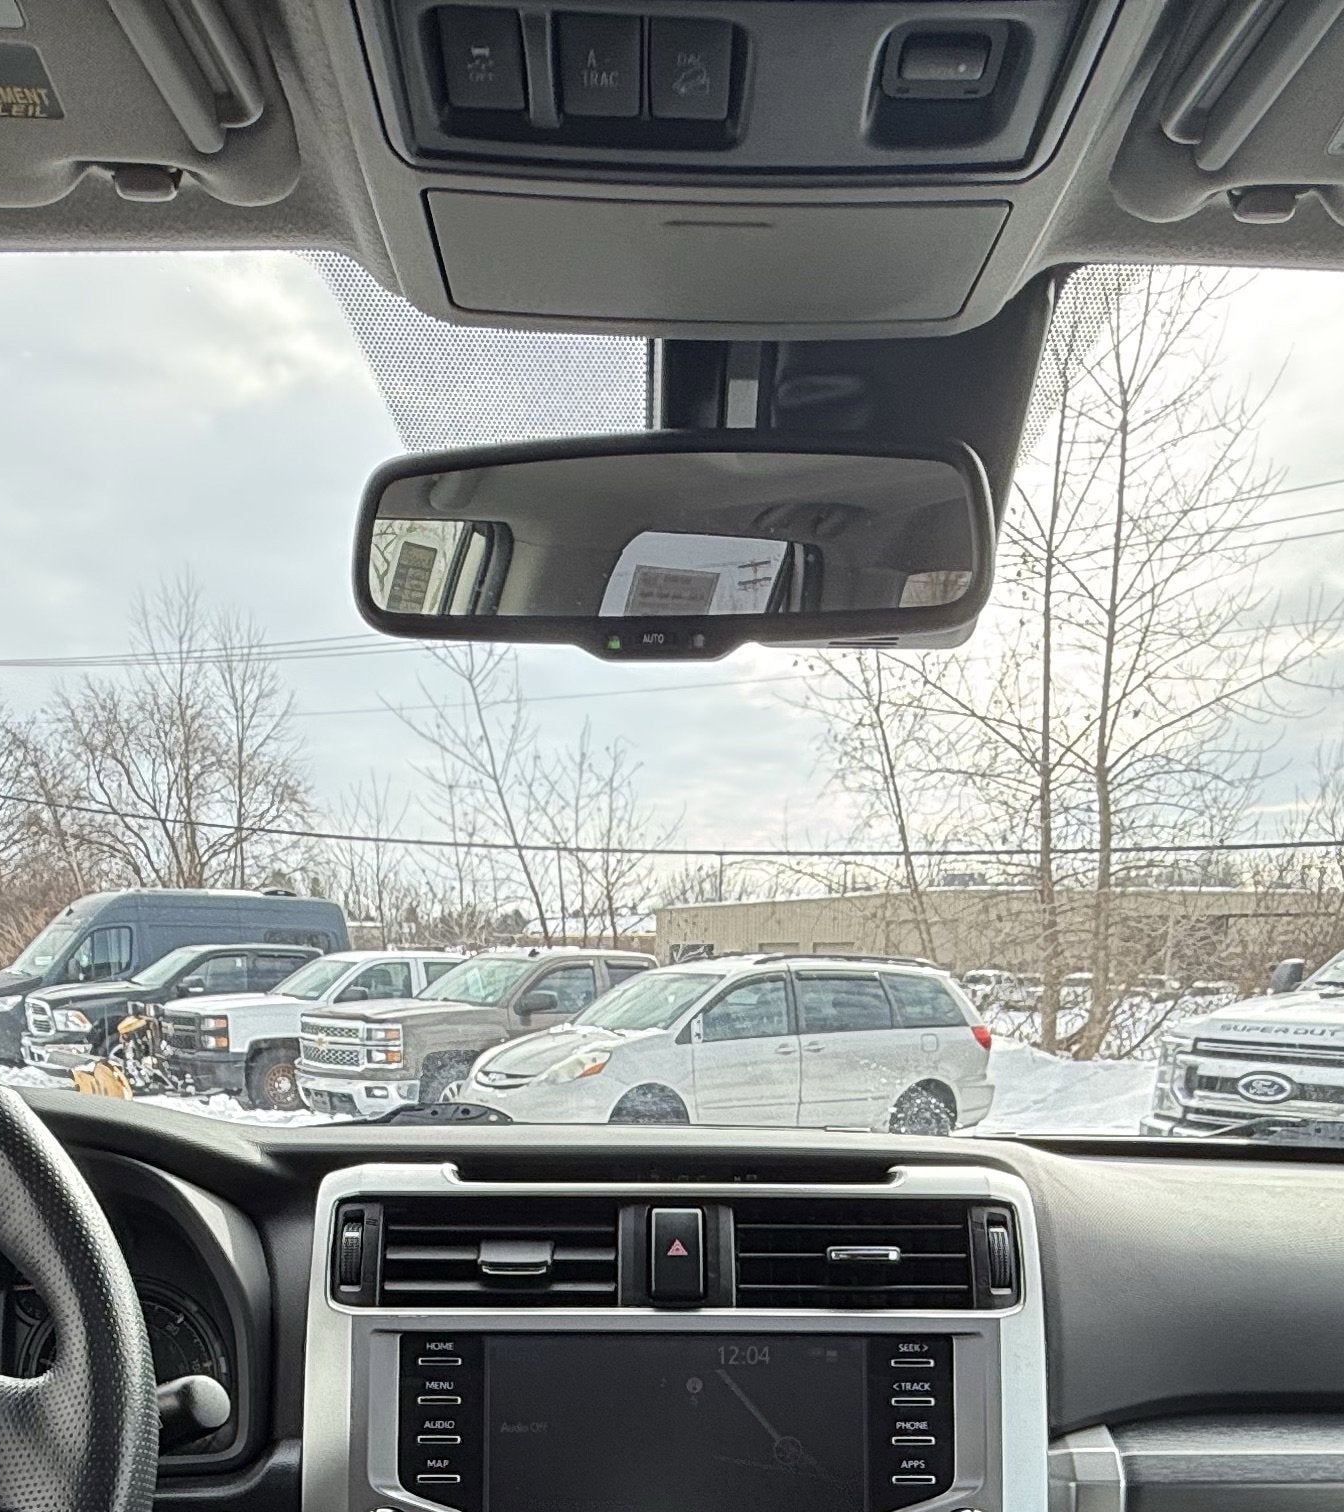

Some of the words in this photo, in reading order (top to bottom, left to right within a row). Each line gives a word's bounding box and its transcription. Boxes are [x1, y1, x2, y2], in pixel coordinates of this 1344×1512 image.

[583, 69, 619, 88] TRAC
[643, 633, 665, 645] AUTO
[1220, 1023, 1289, 1034] SUPER
[425, 1342, 455, 1351] HOME
[898, 1343, 920, 1352] SEEK
[718, 1346, 771, 1365] 12:04
[425, 1381, 455, 1390] MENU
[901, 1382, 931, 1391] TRACK
[423, 1420, 456, 1429] AUDIO
[895, 1421, 929, 1430] PHONE
[426, 1459, 450, 1468] MAP
[900, 1460, 926, 1469] APPS
